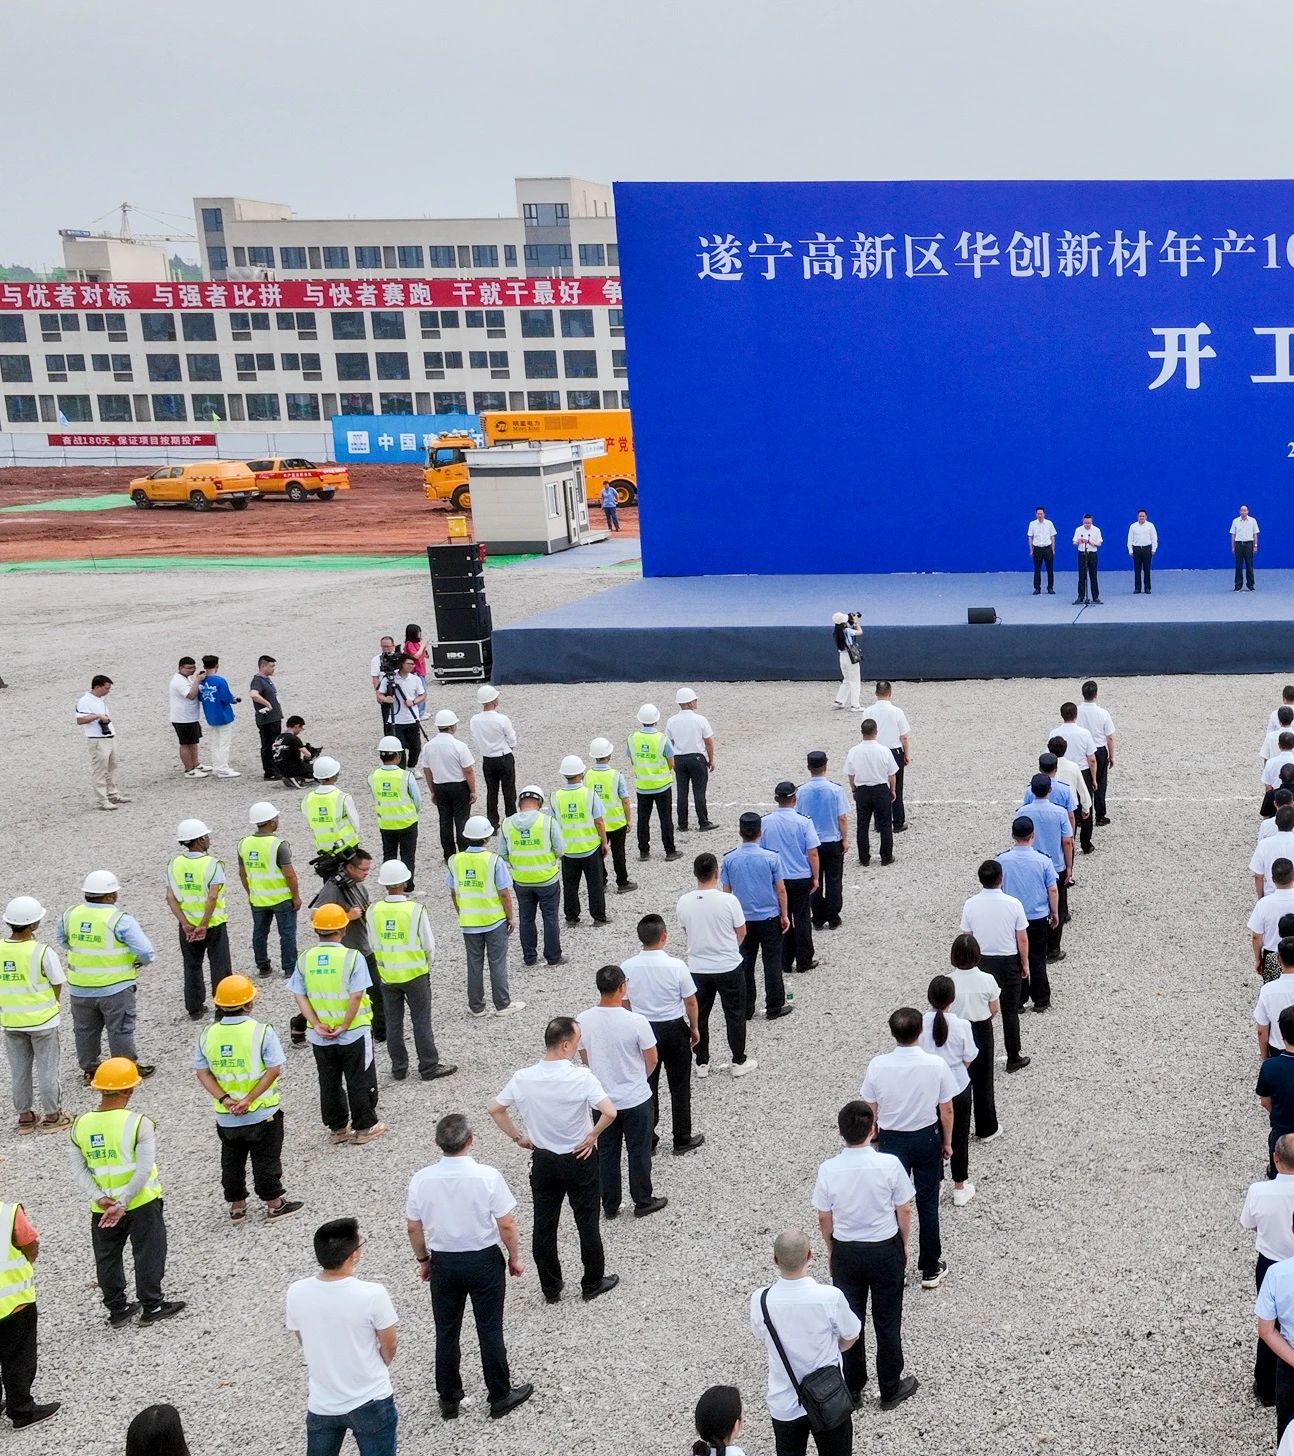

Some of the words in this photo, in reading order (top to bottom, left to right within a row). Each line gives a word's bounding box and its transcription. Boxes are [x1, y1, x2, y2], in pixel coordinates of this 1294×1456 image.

[1, 283, 132, 307] 与优者对标
[152, 283, 283, 308] 与强者比拼
[303, 283, 434, 308] 与快者赛跑
[452, 281, 583, 306] 干就干最好
